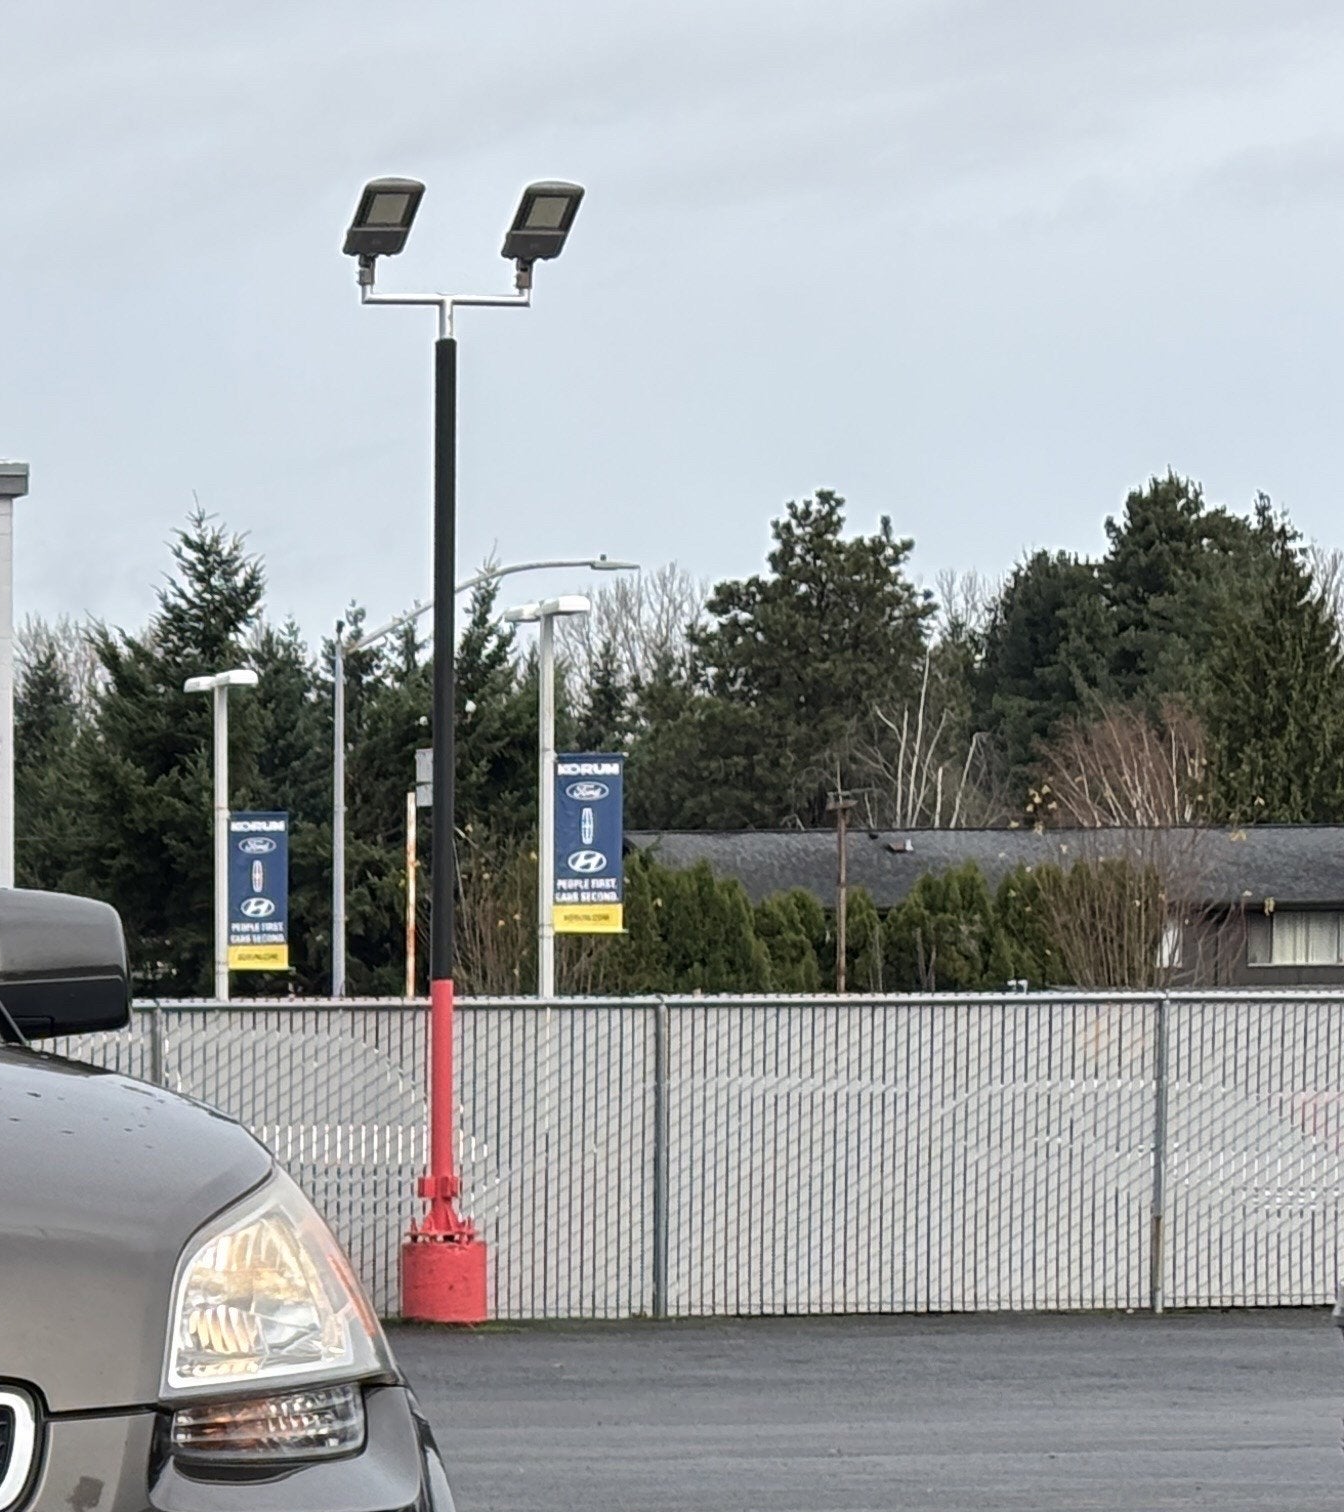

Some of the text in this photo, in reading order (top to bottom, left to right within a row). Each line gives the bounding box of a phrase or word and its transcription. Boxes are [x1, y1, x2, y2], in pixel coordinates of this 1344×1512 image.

[557, 763, 620, 775] KORUM
[230, 820, 285, 832] KORUM
[557, 878, 590, 890] PEOPLE
